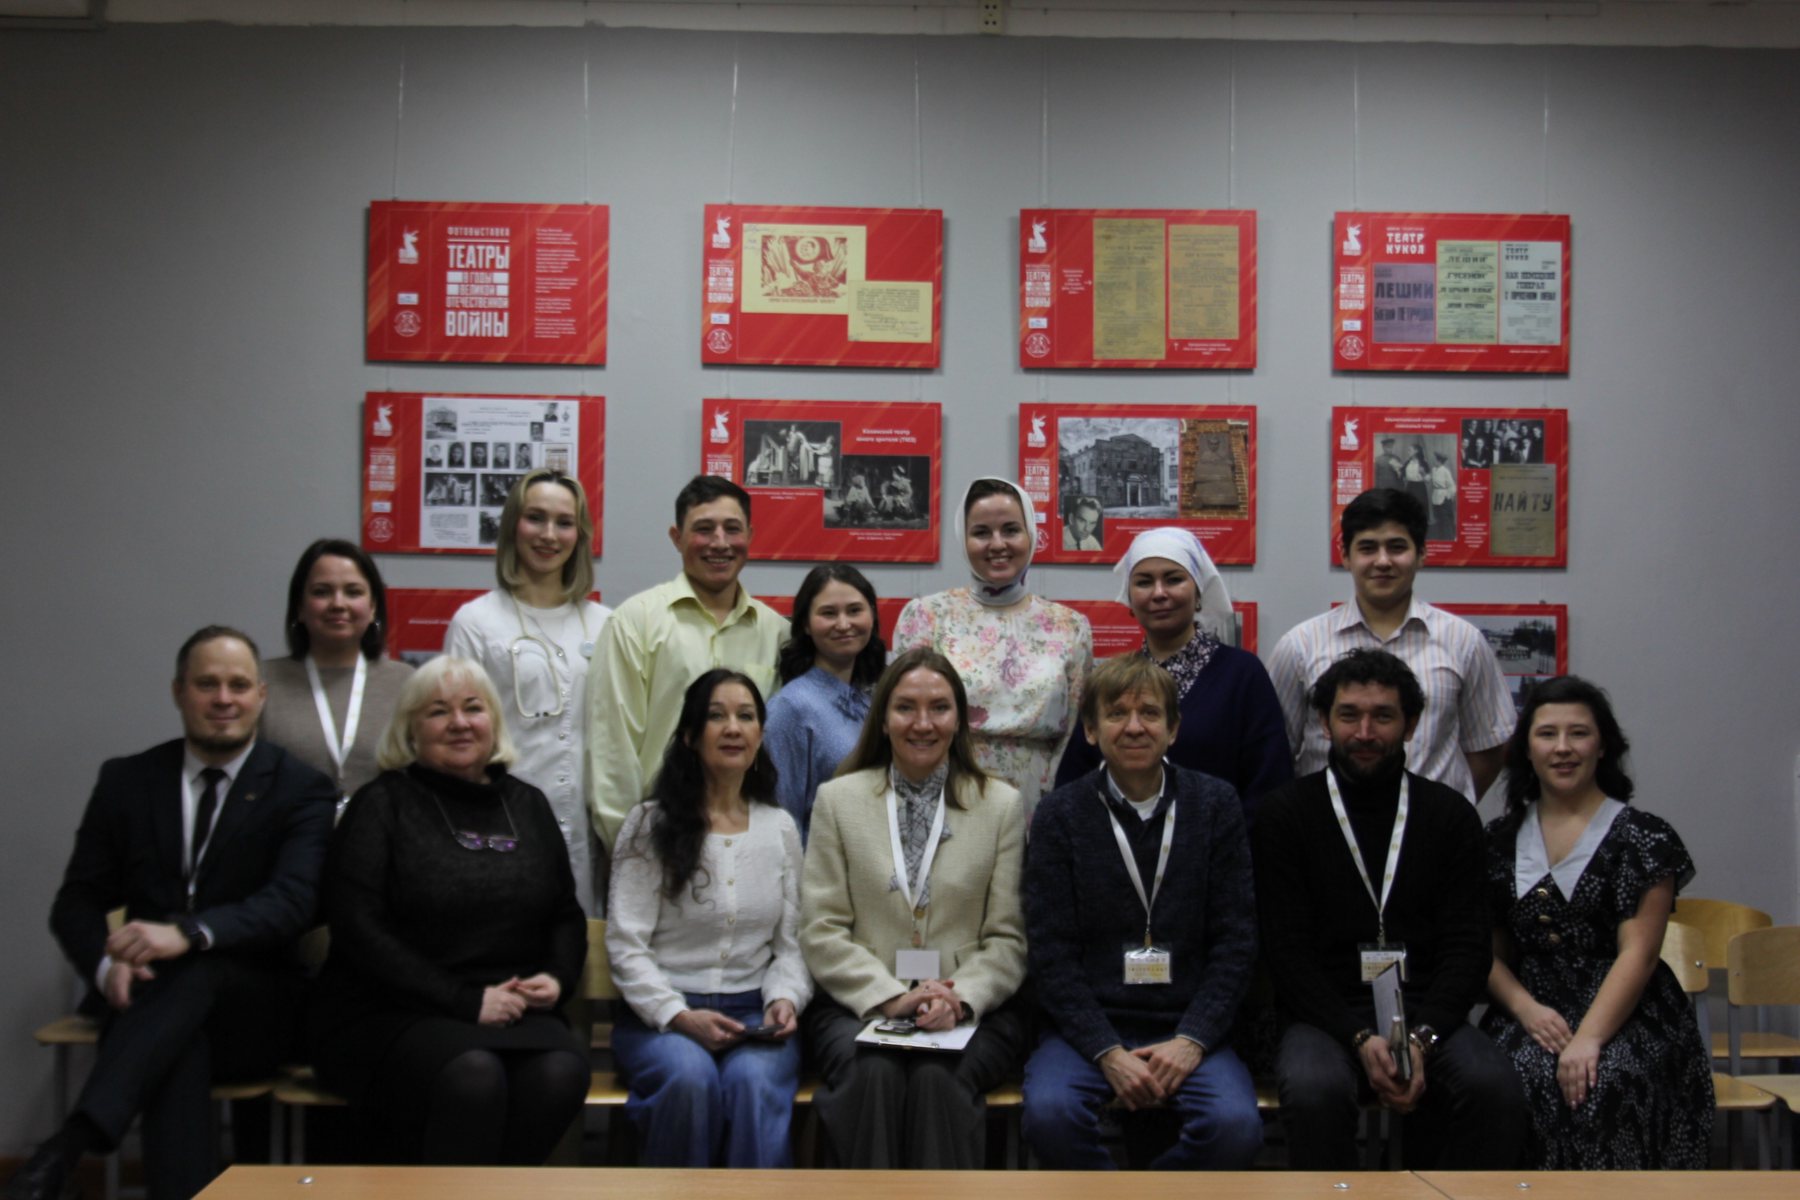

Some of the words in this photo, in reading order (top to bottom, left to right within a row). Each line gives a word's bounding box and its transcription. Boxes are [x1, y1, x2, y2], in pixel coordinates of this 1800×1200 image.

[1386, 233, 1425, 243] ТЕАТР
[447, 244, 510, 269] ТЕАТРЫ
[1386, 244, 1425, 255] КУКОЛ
[446, 311, 509, 337] ВОЙНЫ
